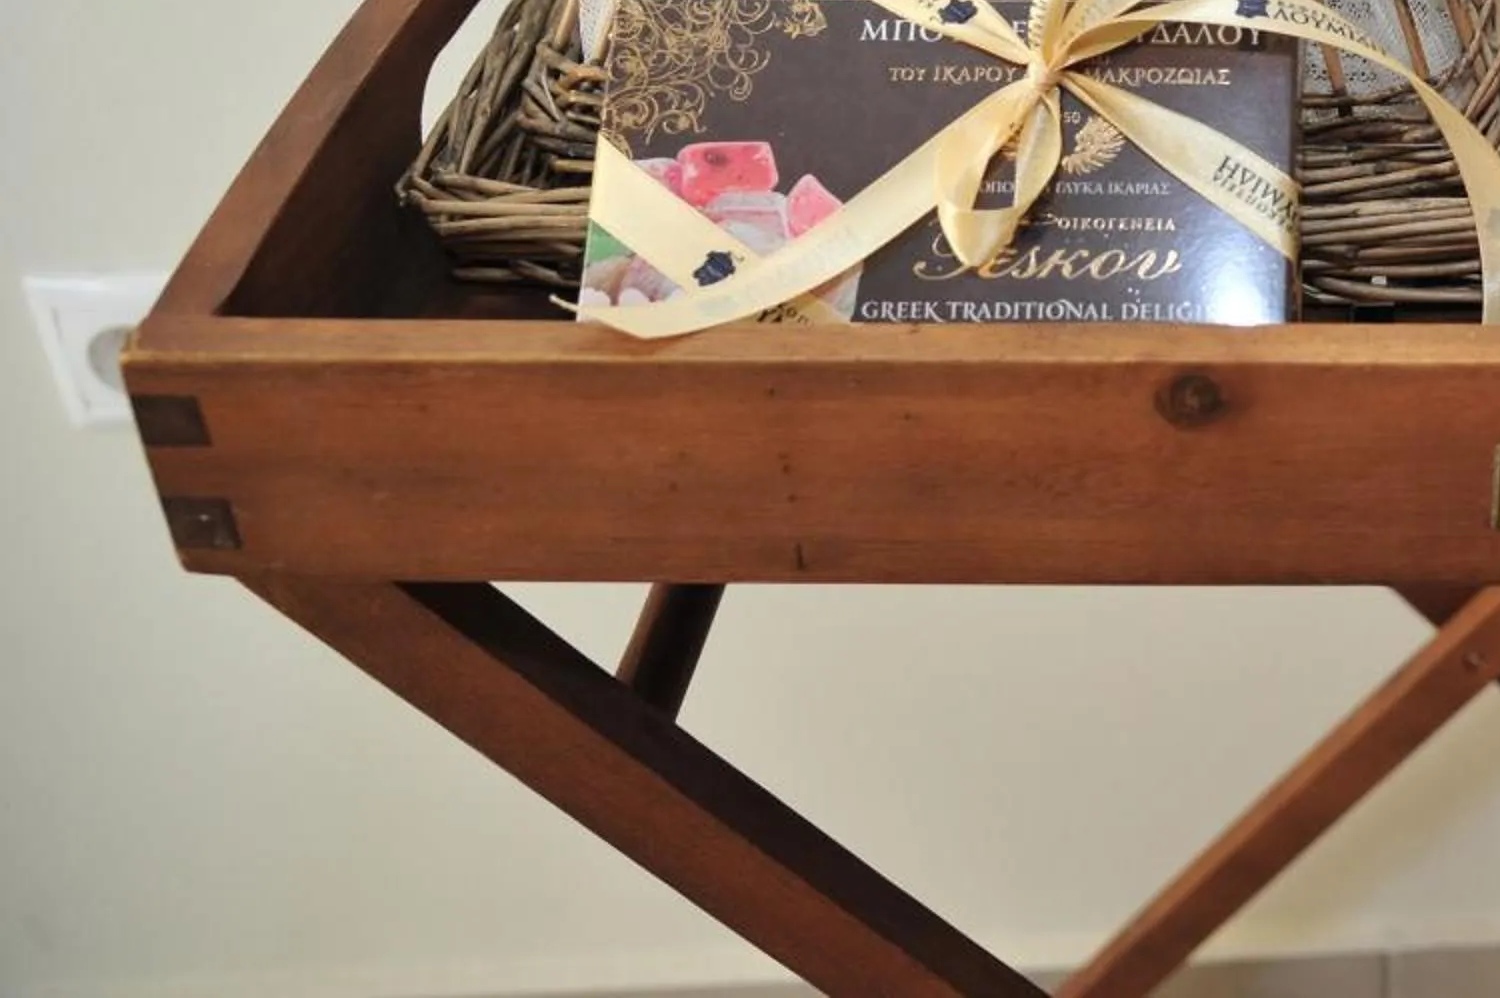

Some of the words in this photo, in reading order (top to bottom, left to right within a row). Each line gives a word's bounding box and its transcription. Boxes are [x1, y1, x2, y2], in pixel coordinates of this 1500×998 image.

[888, 67, 926, 82] ΤΟΥ
[933, 66, 1017, 85] ΙΚΑΡΟΥ
[1055, 181, 1103, 195] ΓΛΥΚΑ
[1108, 181, 1171, 195] ΙΚΑΡΙΑΣ
[861, 301, 945, 324] GREEK
[946, 299, 1111, 324] TRADITIONAL
